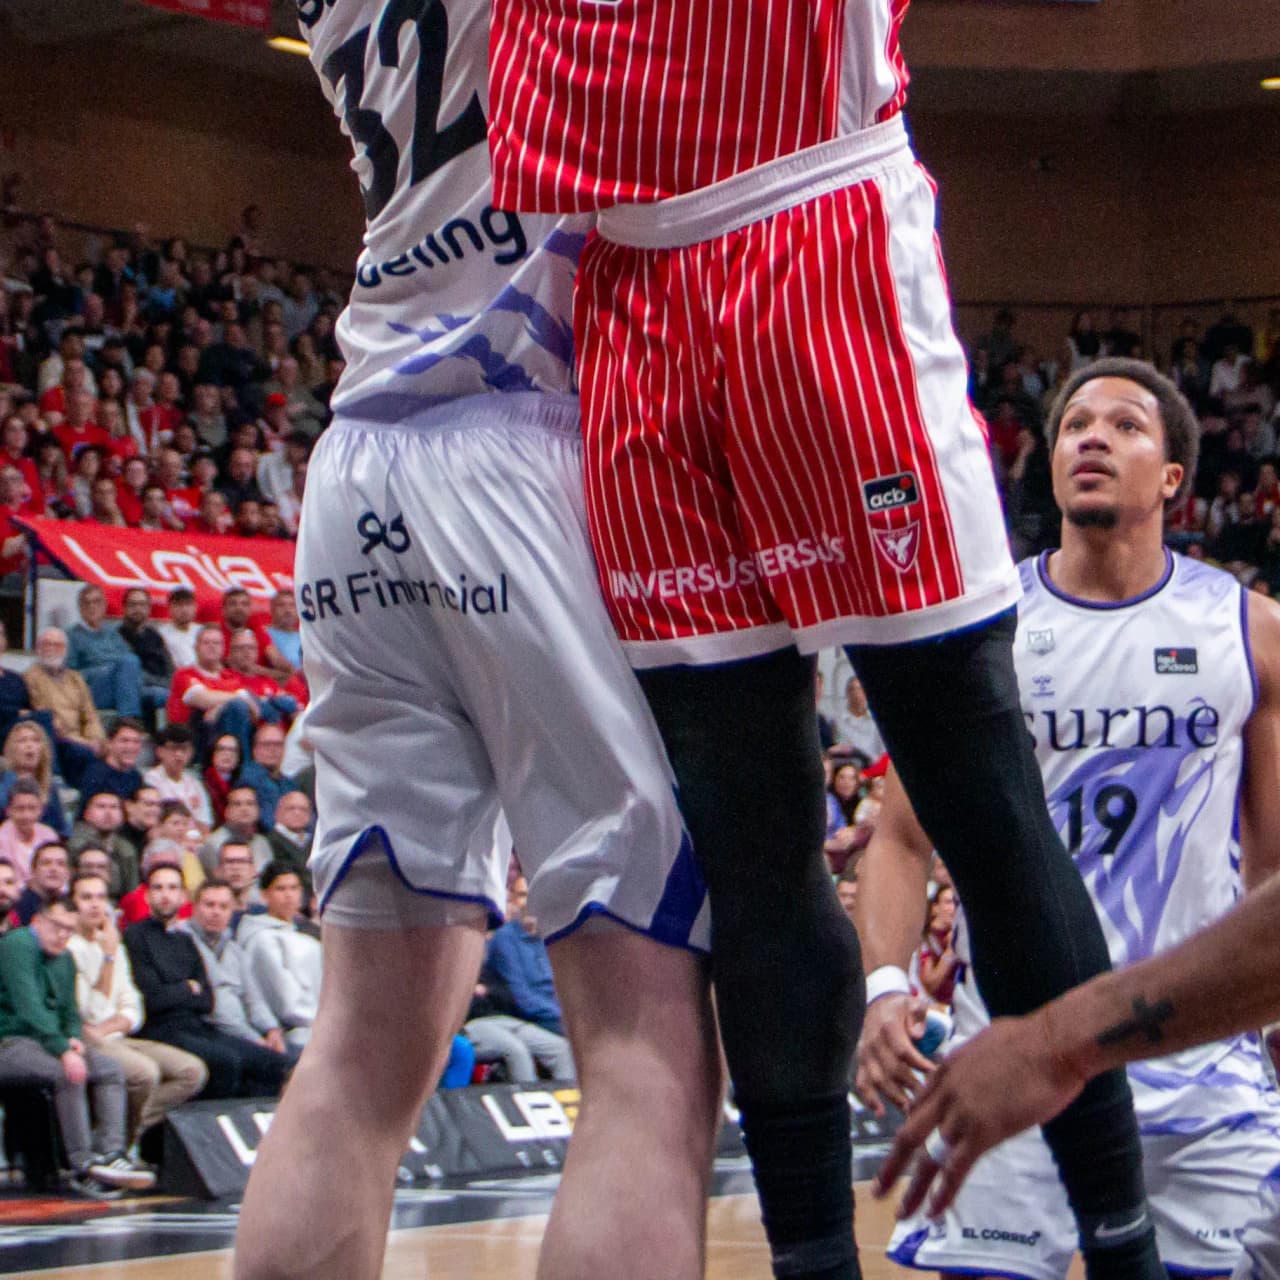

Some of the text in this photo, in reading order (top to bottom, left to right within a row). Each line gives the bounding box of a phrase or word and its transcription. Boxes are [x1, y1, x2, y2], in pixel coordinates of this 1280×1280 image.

[869, 488, 907, 509] acb
[612, 532, 846, 600] INVERSUS ERSUS
[301, 577, 343, 622] SR
[1061, 782, 1139, 856] 19
[962, 1227, 977, 1239] EL
